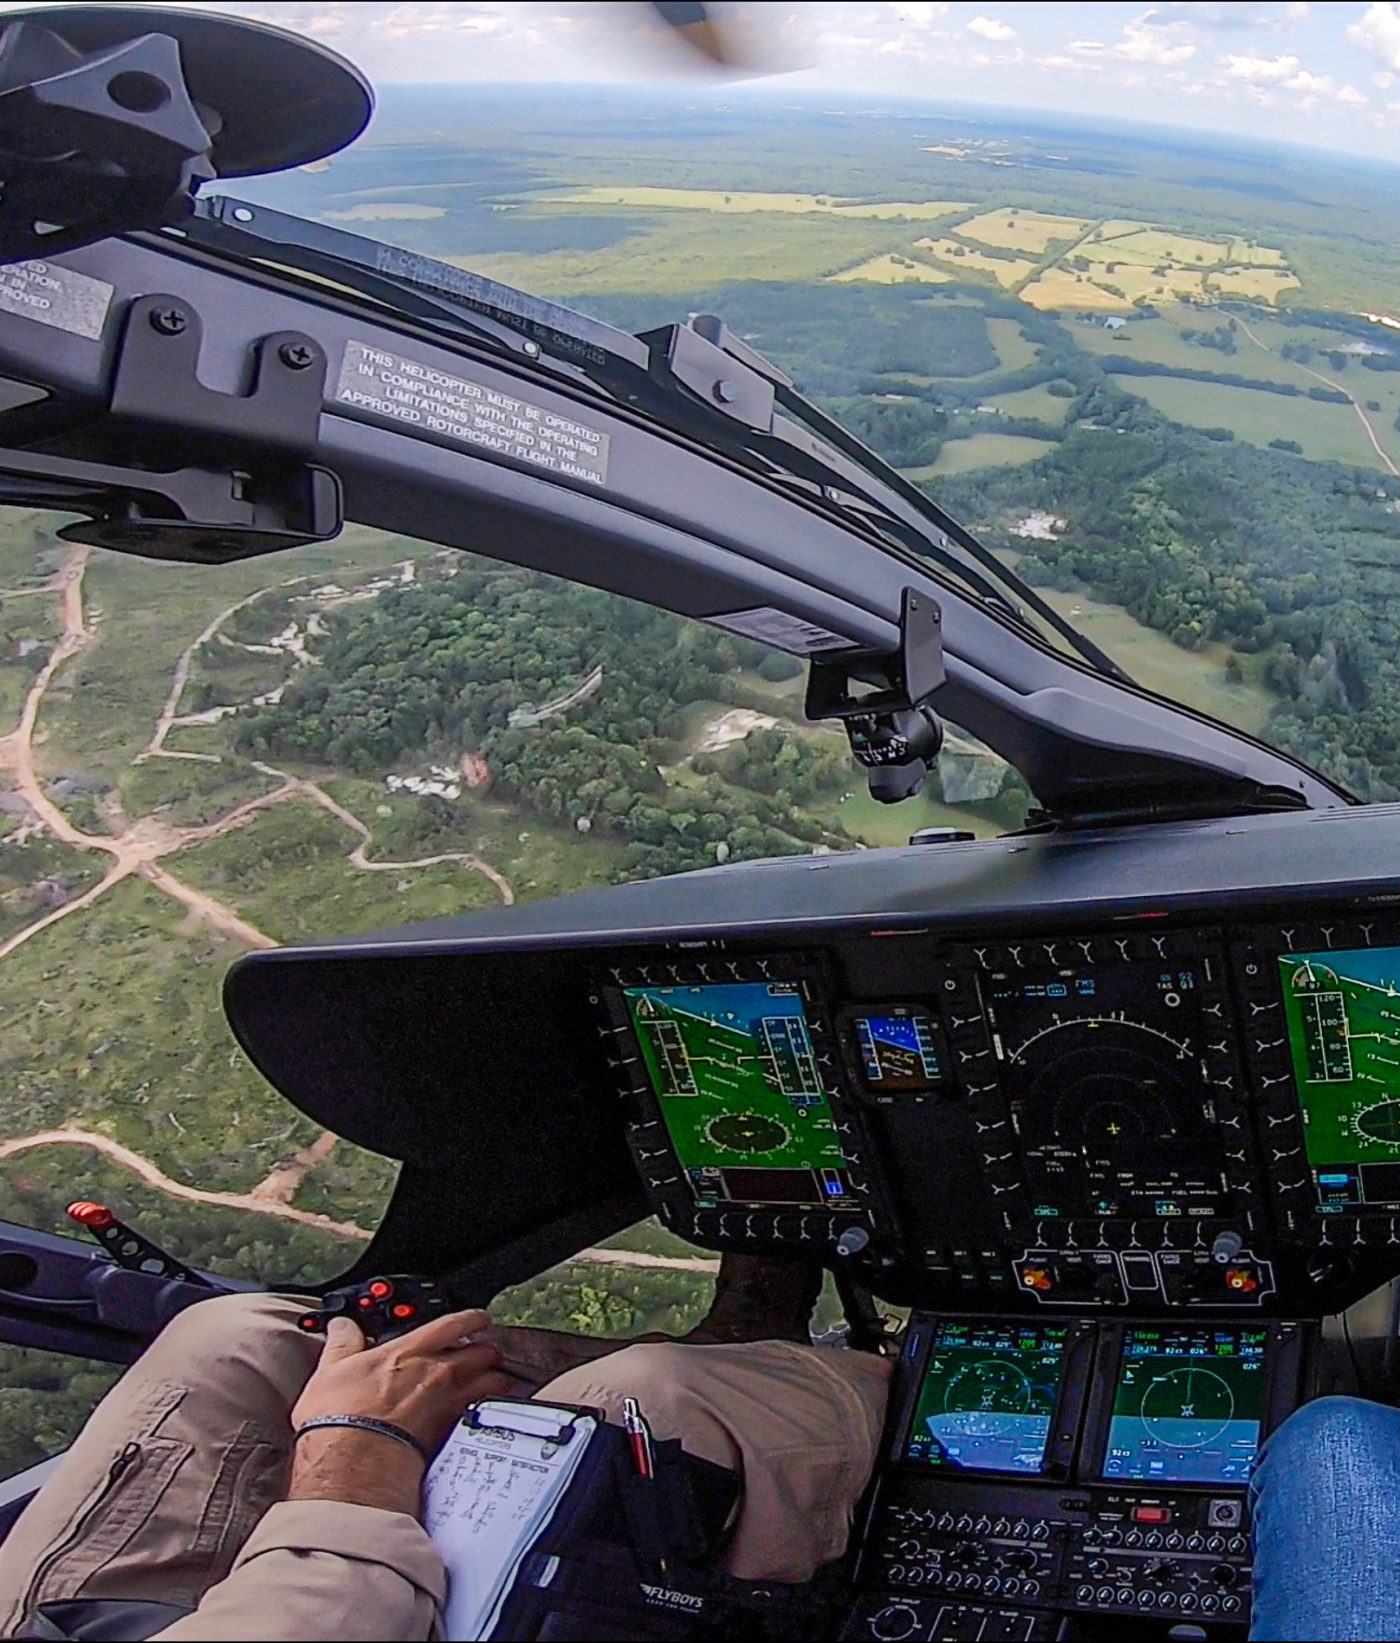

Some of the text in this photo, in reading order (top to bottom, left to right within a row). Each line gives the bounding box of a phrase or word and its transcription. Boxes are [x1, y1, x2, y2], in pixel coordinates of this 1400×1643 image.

[340, 389, 603, 485] APPROVED ROTORCRAFT FLIGHT MANUAL
[359, 363, 598, 456] IN COMPLIANCE WITH THE OPERATING
[361, 347, 600, 443] THIS HELICOPTER MUST BE OPERATED
[385, 386, 578, 462] LIMITATIONS SPECIFIED IN THE
[649, 1586, 704, 1607] FLYBOYS
